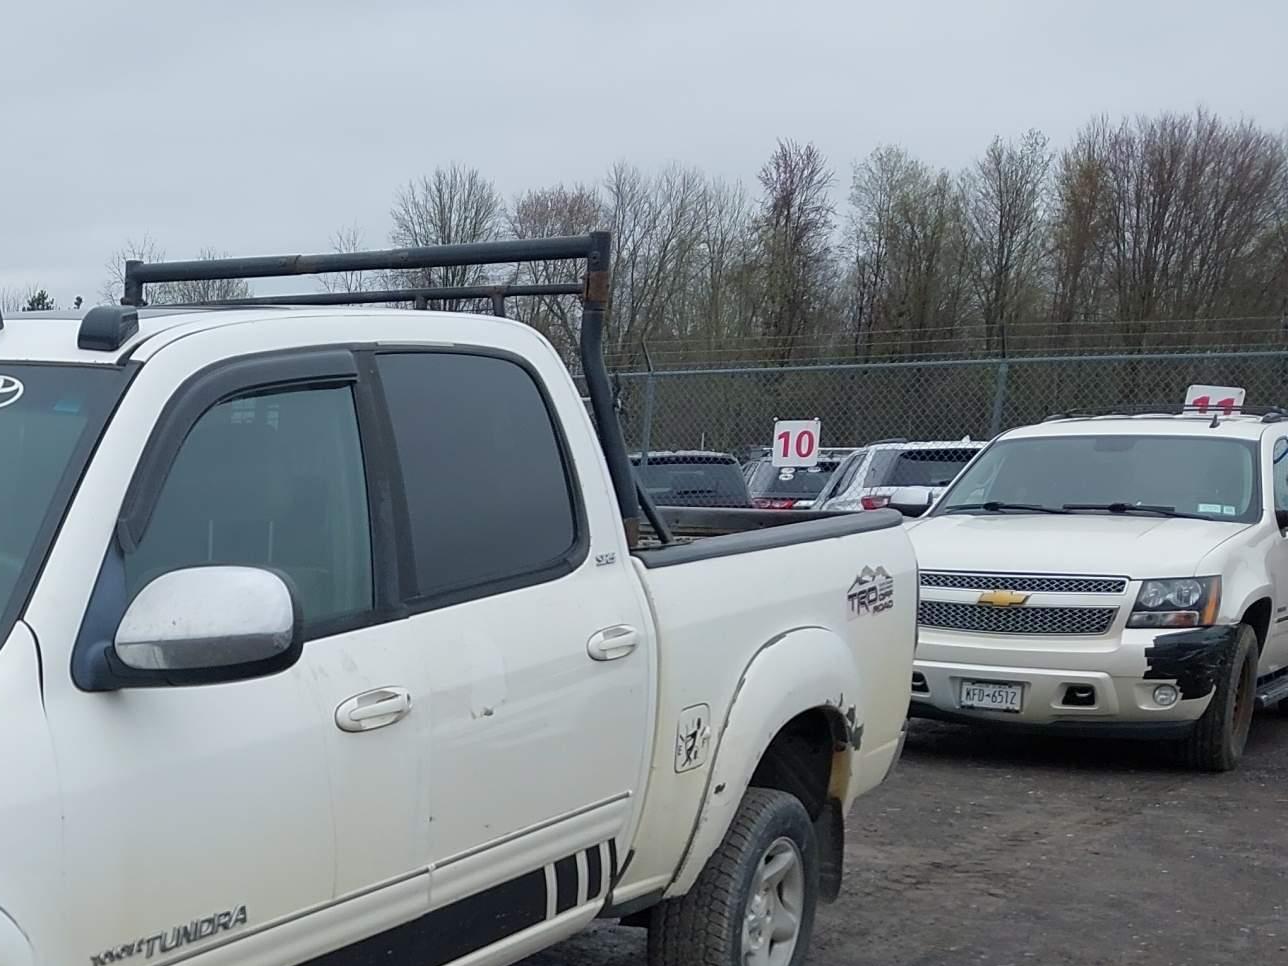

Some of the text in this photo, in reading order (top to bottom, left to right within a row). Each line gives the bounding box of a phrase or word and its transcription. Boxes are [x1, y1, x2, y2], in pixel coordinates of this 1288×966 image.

[1192, 395, 1235, 416] 11
[777, 430, 814, 458] 10
[145, 904, 247, 959] TUNDRA
